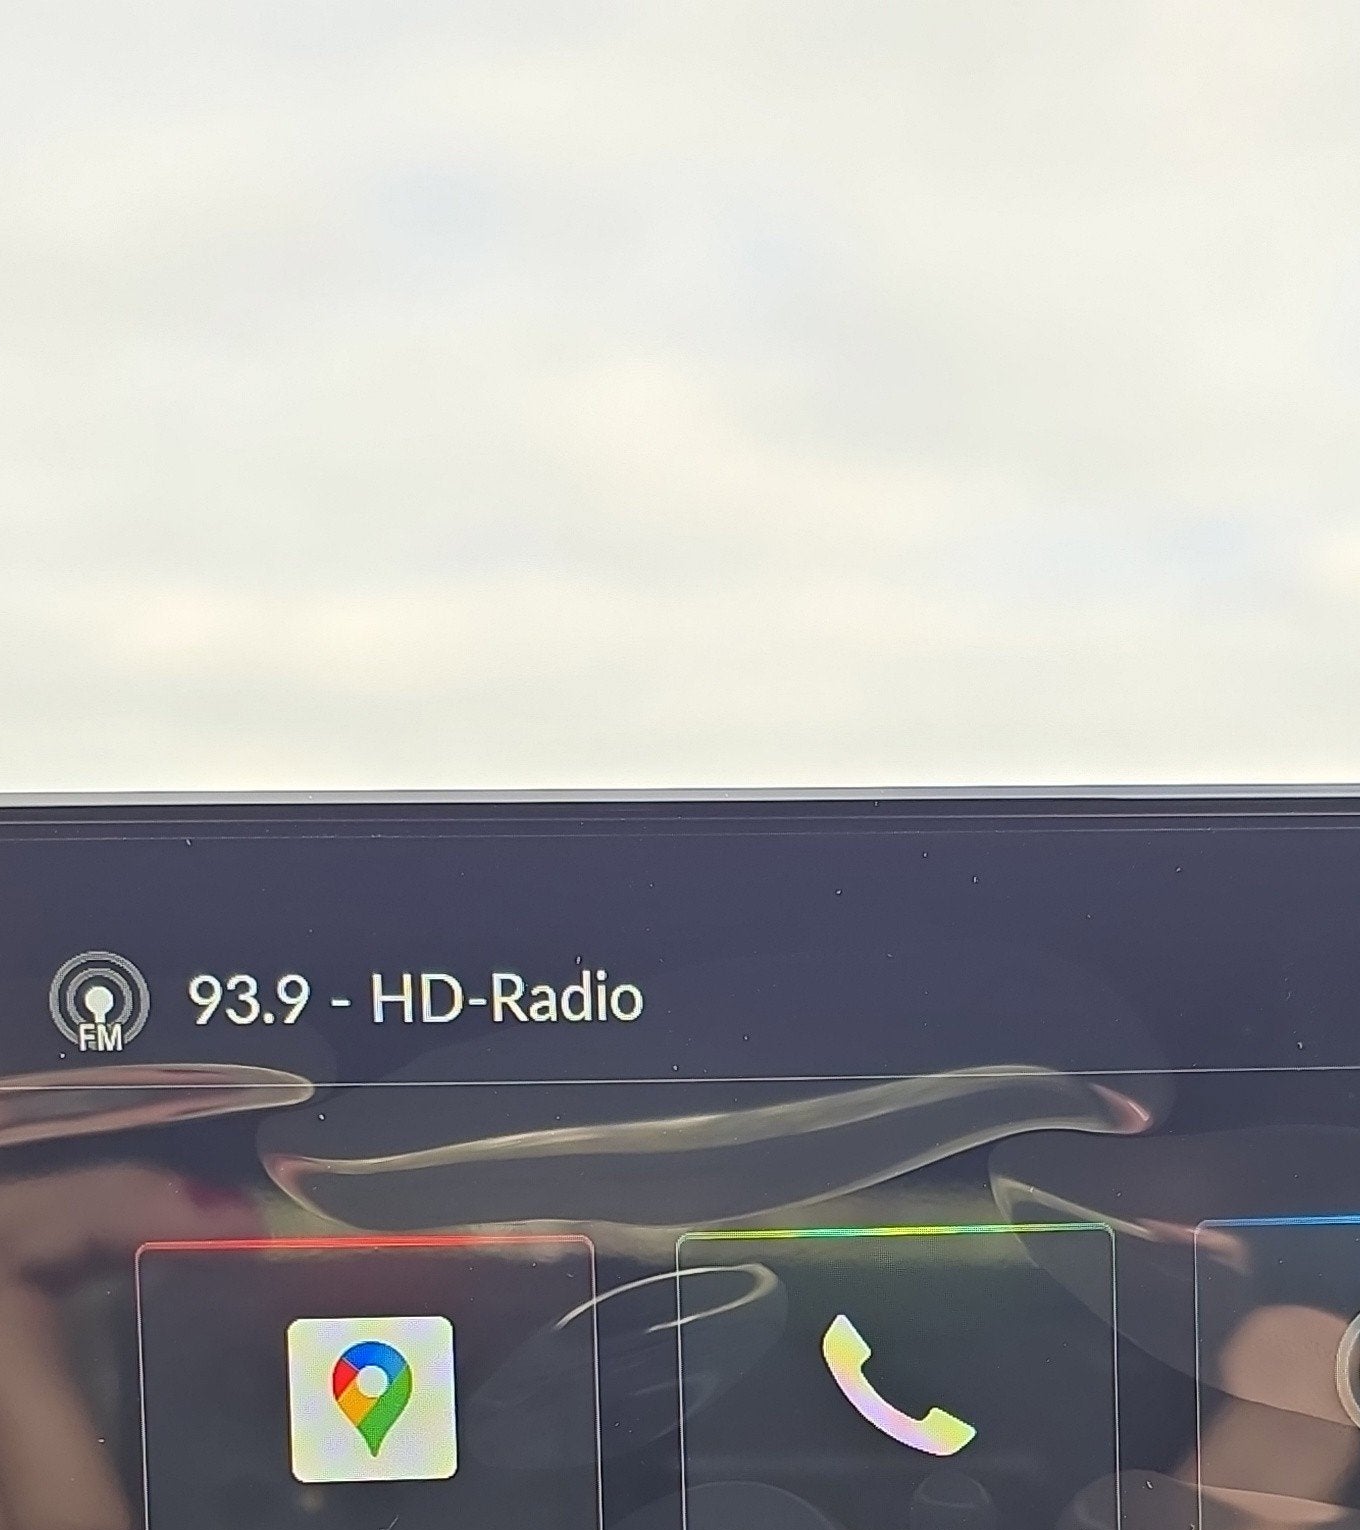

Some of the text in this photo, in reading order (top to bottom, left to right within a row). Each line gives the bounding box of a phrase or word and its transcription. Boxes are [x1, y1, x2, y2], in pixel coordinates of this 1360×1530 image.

[187, 973, 311, 1027] 93.9
[369, 970, 644, 1026] HD-Radio
[78, 1022, 124, 1053] FM
